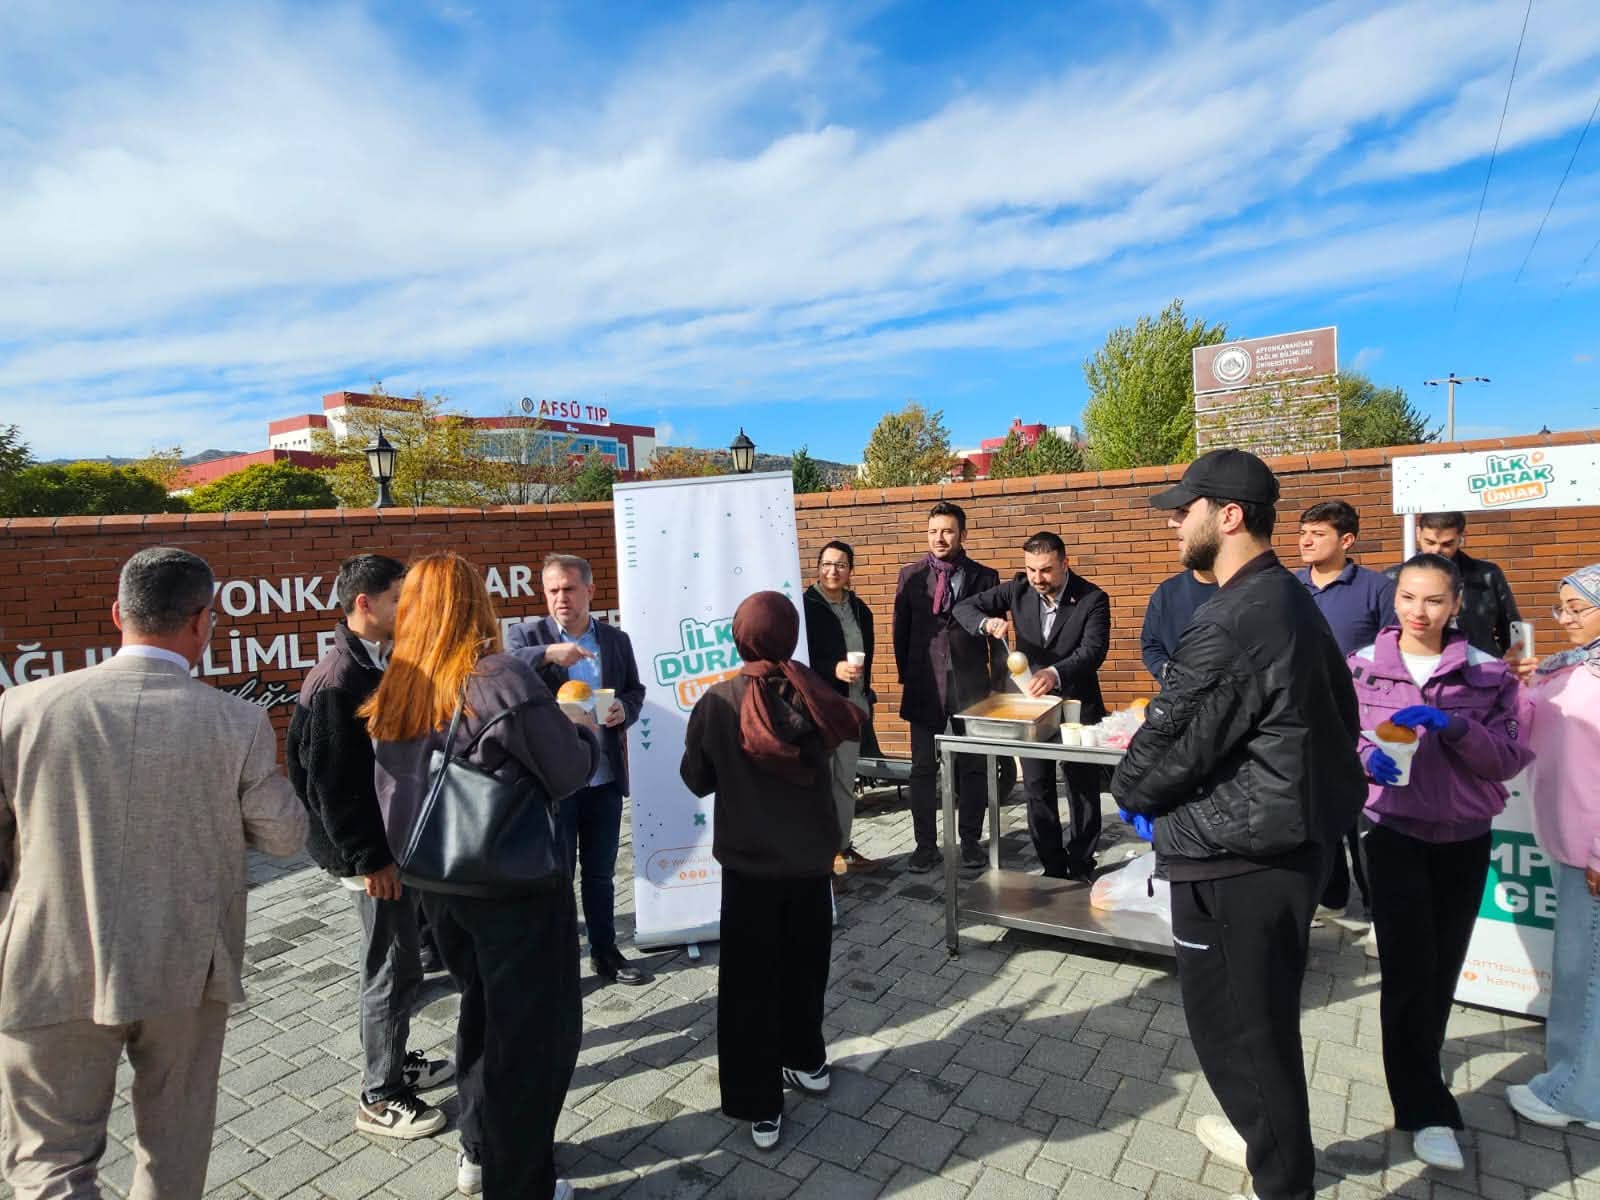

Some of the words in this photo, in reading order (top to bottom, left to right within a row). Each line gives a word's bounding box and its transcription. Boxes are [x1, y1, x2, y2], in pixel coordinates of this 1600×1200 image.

[539, 399, 580, 419] AFSÜ
[1489, 457, 1525, 474] İLK
[1471, 467, 1551, 490] DURAK
[685, 623, 734, 651] İLK
[660, 646, 744, 680] DURA
